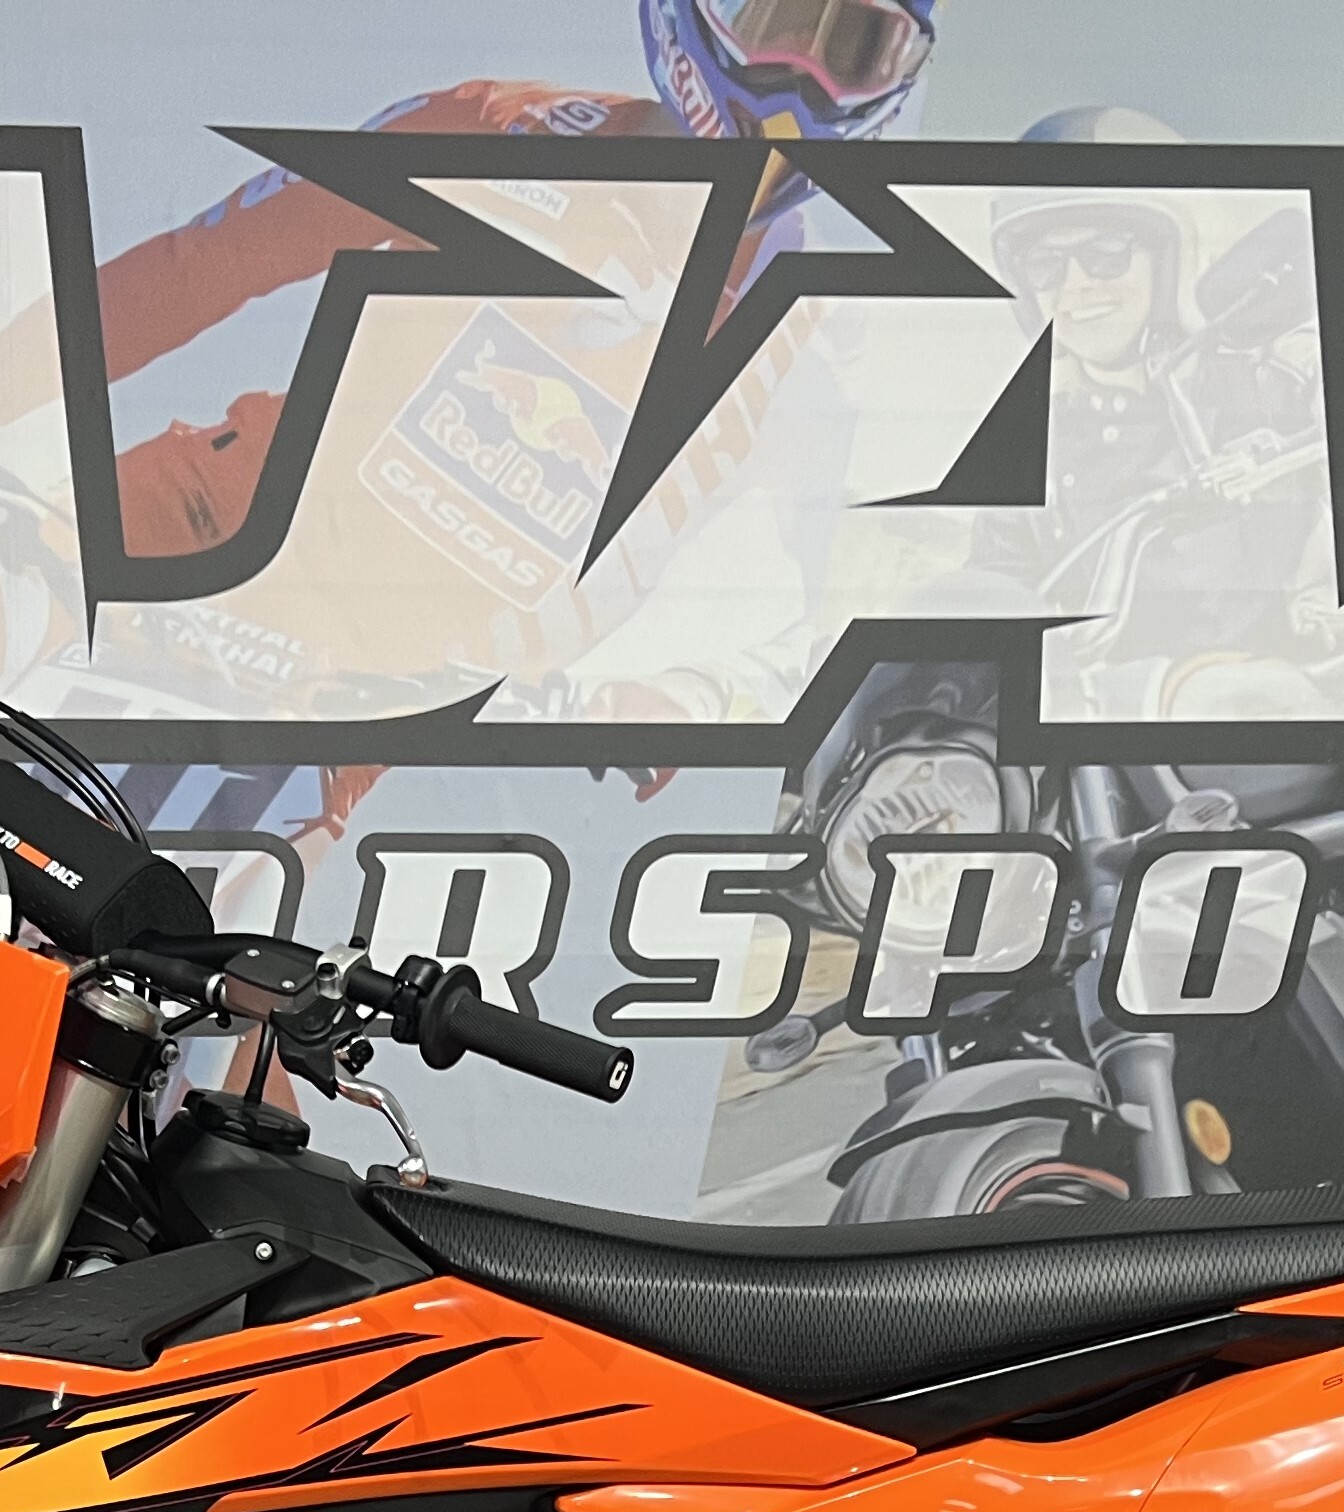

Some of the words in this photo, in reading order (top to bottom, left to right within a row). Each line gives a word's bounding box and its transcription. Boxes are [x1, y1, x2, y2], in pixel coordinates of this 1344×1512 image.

[378, 459, 545, 568] GASGAS
[0, 830, 20, 850] TO
[44, 860, 83, 889] RACE
